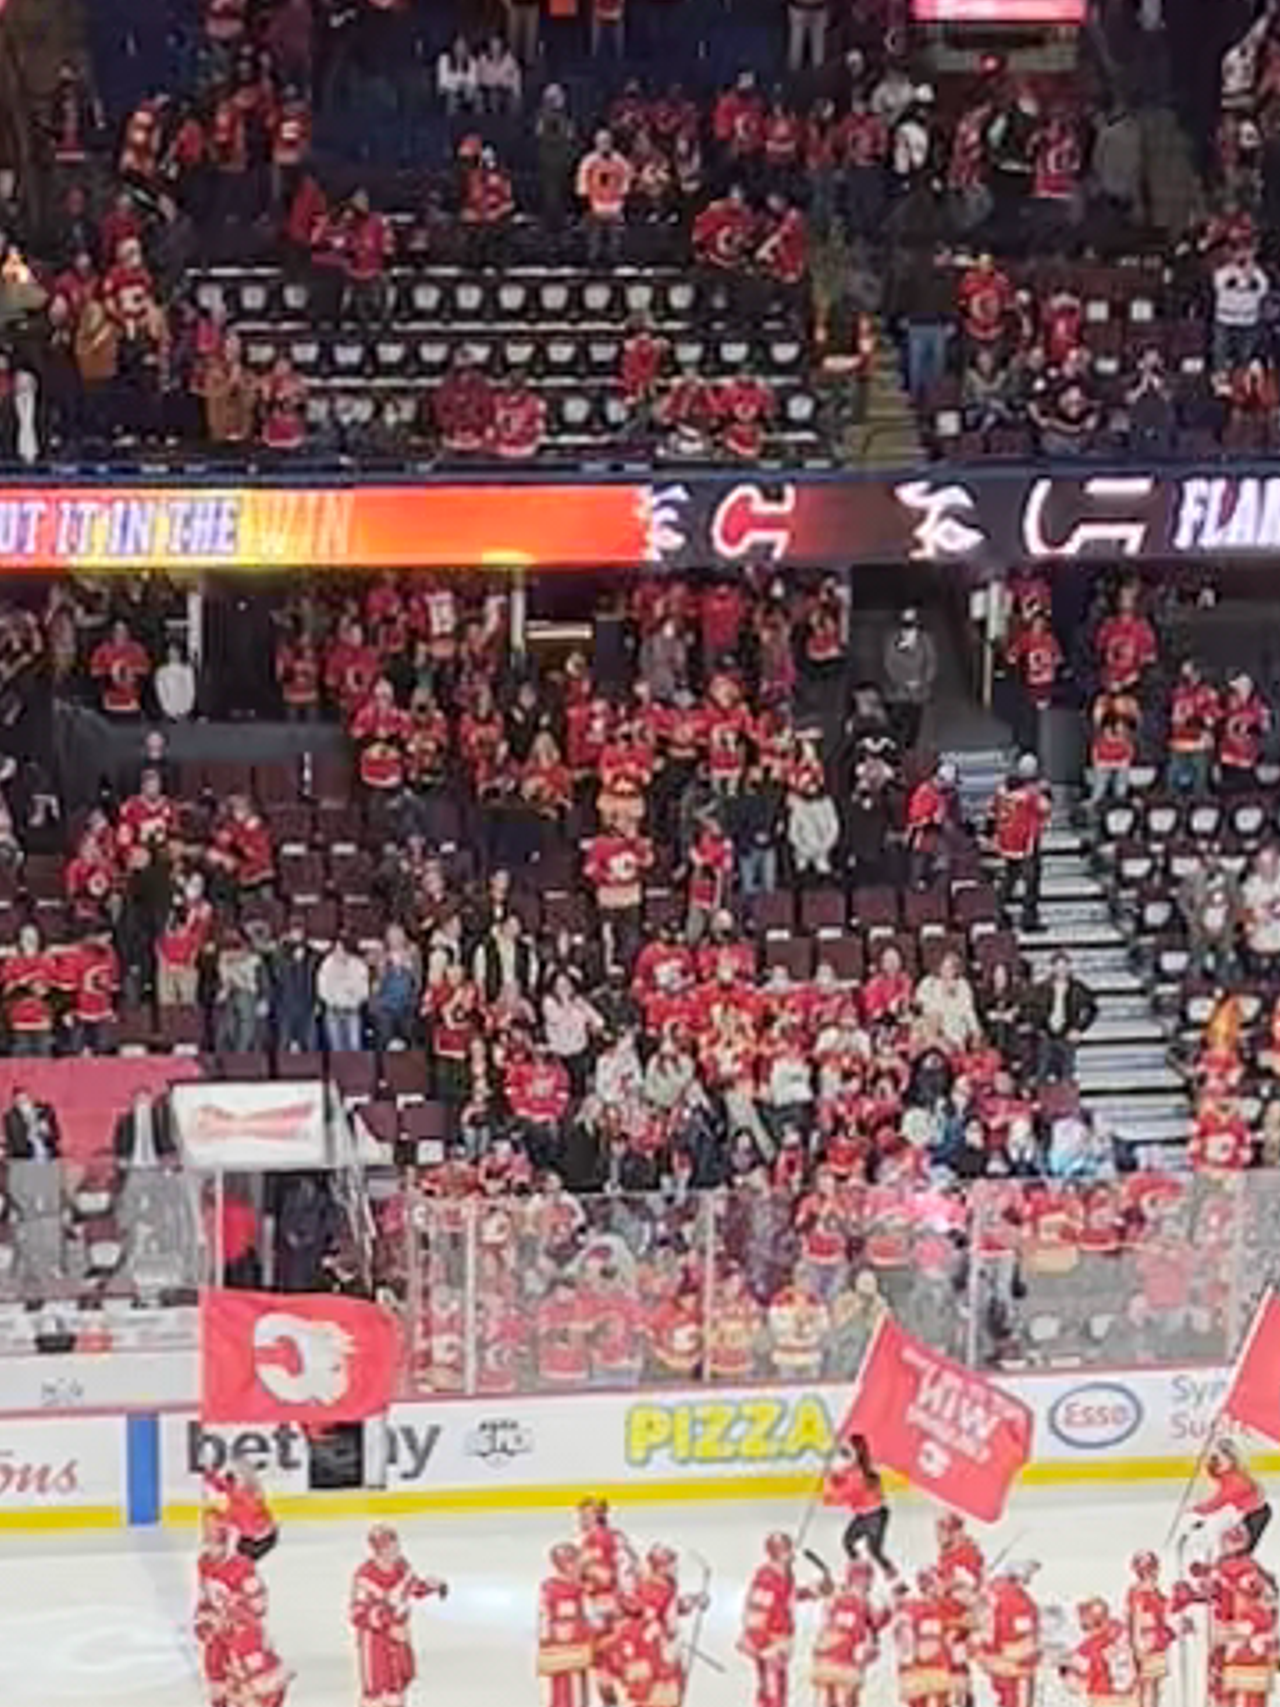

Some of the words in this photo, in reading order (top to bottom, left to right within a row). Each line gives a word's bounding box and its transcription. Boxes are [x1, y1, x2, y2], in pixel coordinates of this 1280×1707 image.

[53, 501, 104, 556] IT
[108, 499, 156, 556] IN
[166, 499, 239, 554] THE
[258, 495, 358, 556] WIN
[625, 1395, 834, 1465] PIZZA
[1064, 1401, 1130, 1429] Esso
[188, 1419, 441, 1480] bety
